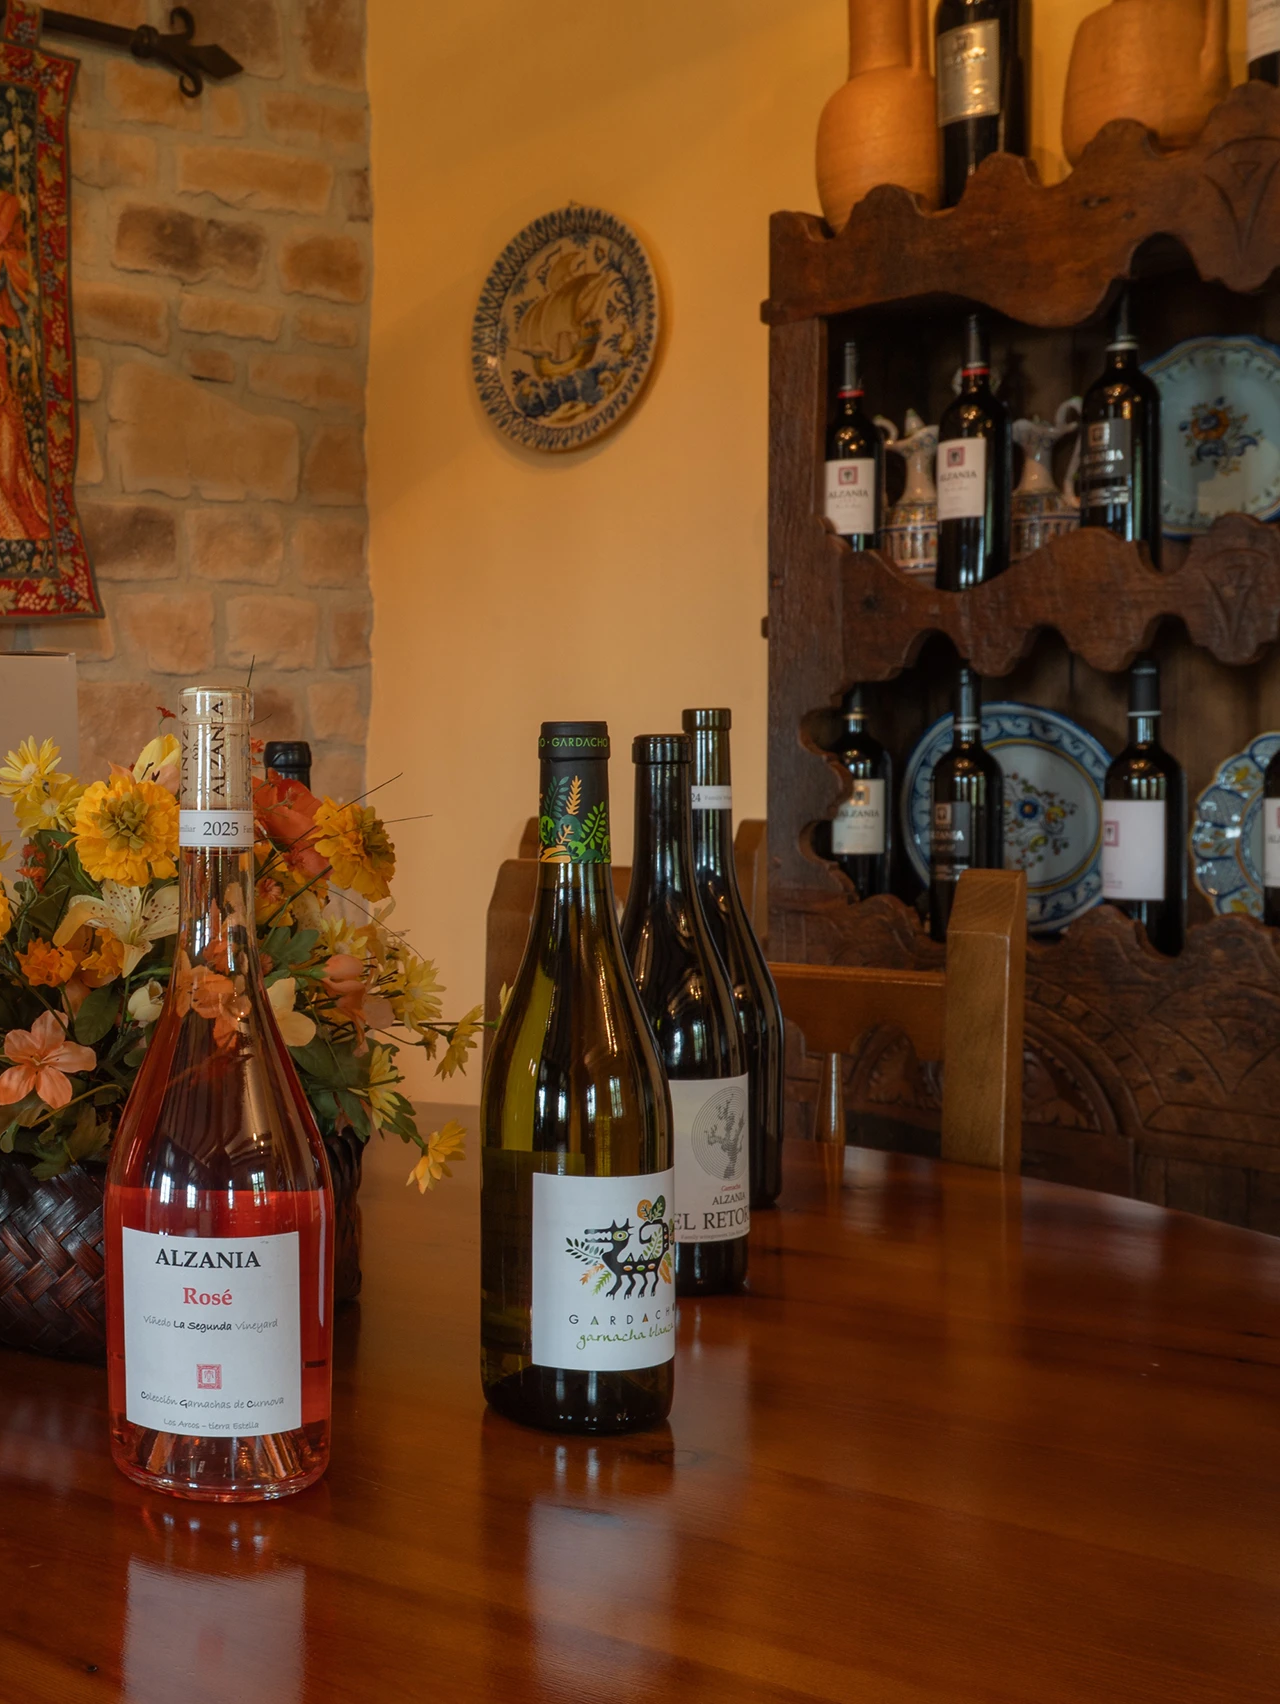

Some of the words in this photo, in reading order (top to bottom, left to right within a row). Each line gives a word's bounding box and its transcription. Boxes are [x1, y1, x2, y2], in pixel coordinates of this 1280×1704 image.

[552, 737, 608, 747] GARDACHO
[203, 821, 239, 836] 2025
[155, 1248, 261, 1269] ALZANIA
[183, 1287, 233, 1306] Rosé
[143, 1315, 171, 1327] Viñedo
[173, 1320, 185, 1329] La
[187, 1320, 232, 1333] Segunda
[235, 1318, 278, 1333] Vineyard
[576, 1329, 645, 1350] garnacha
[179, 1399, 232, 1409] Garnachas
[234, 1400, 245, 1408] de
[163, 1418, 176, 1427] Los
[177, 1420, 200, 1429] Arcos
[233, 1421, 259, 1430] Estella
